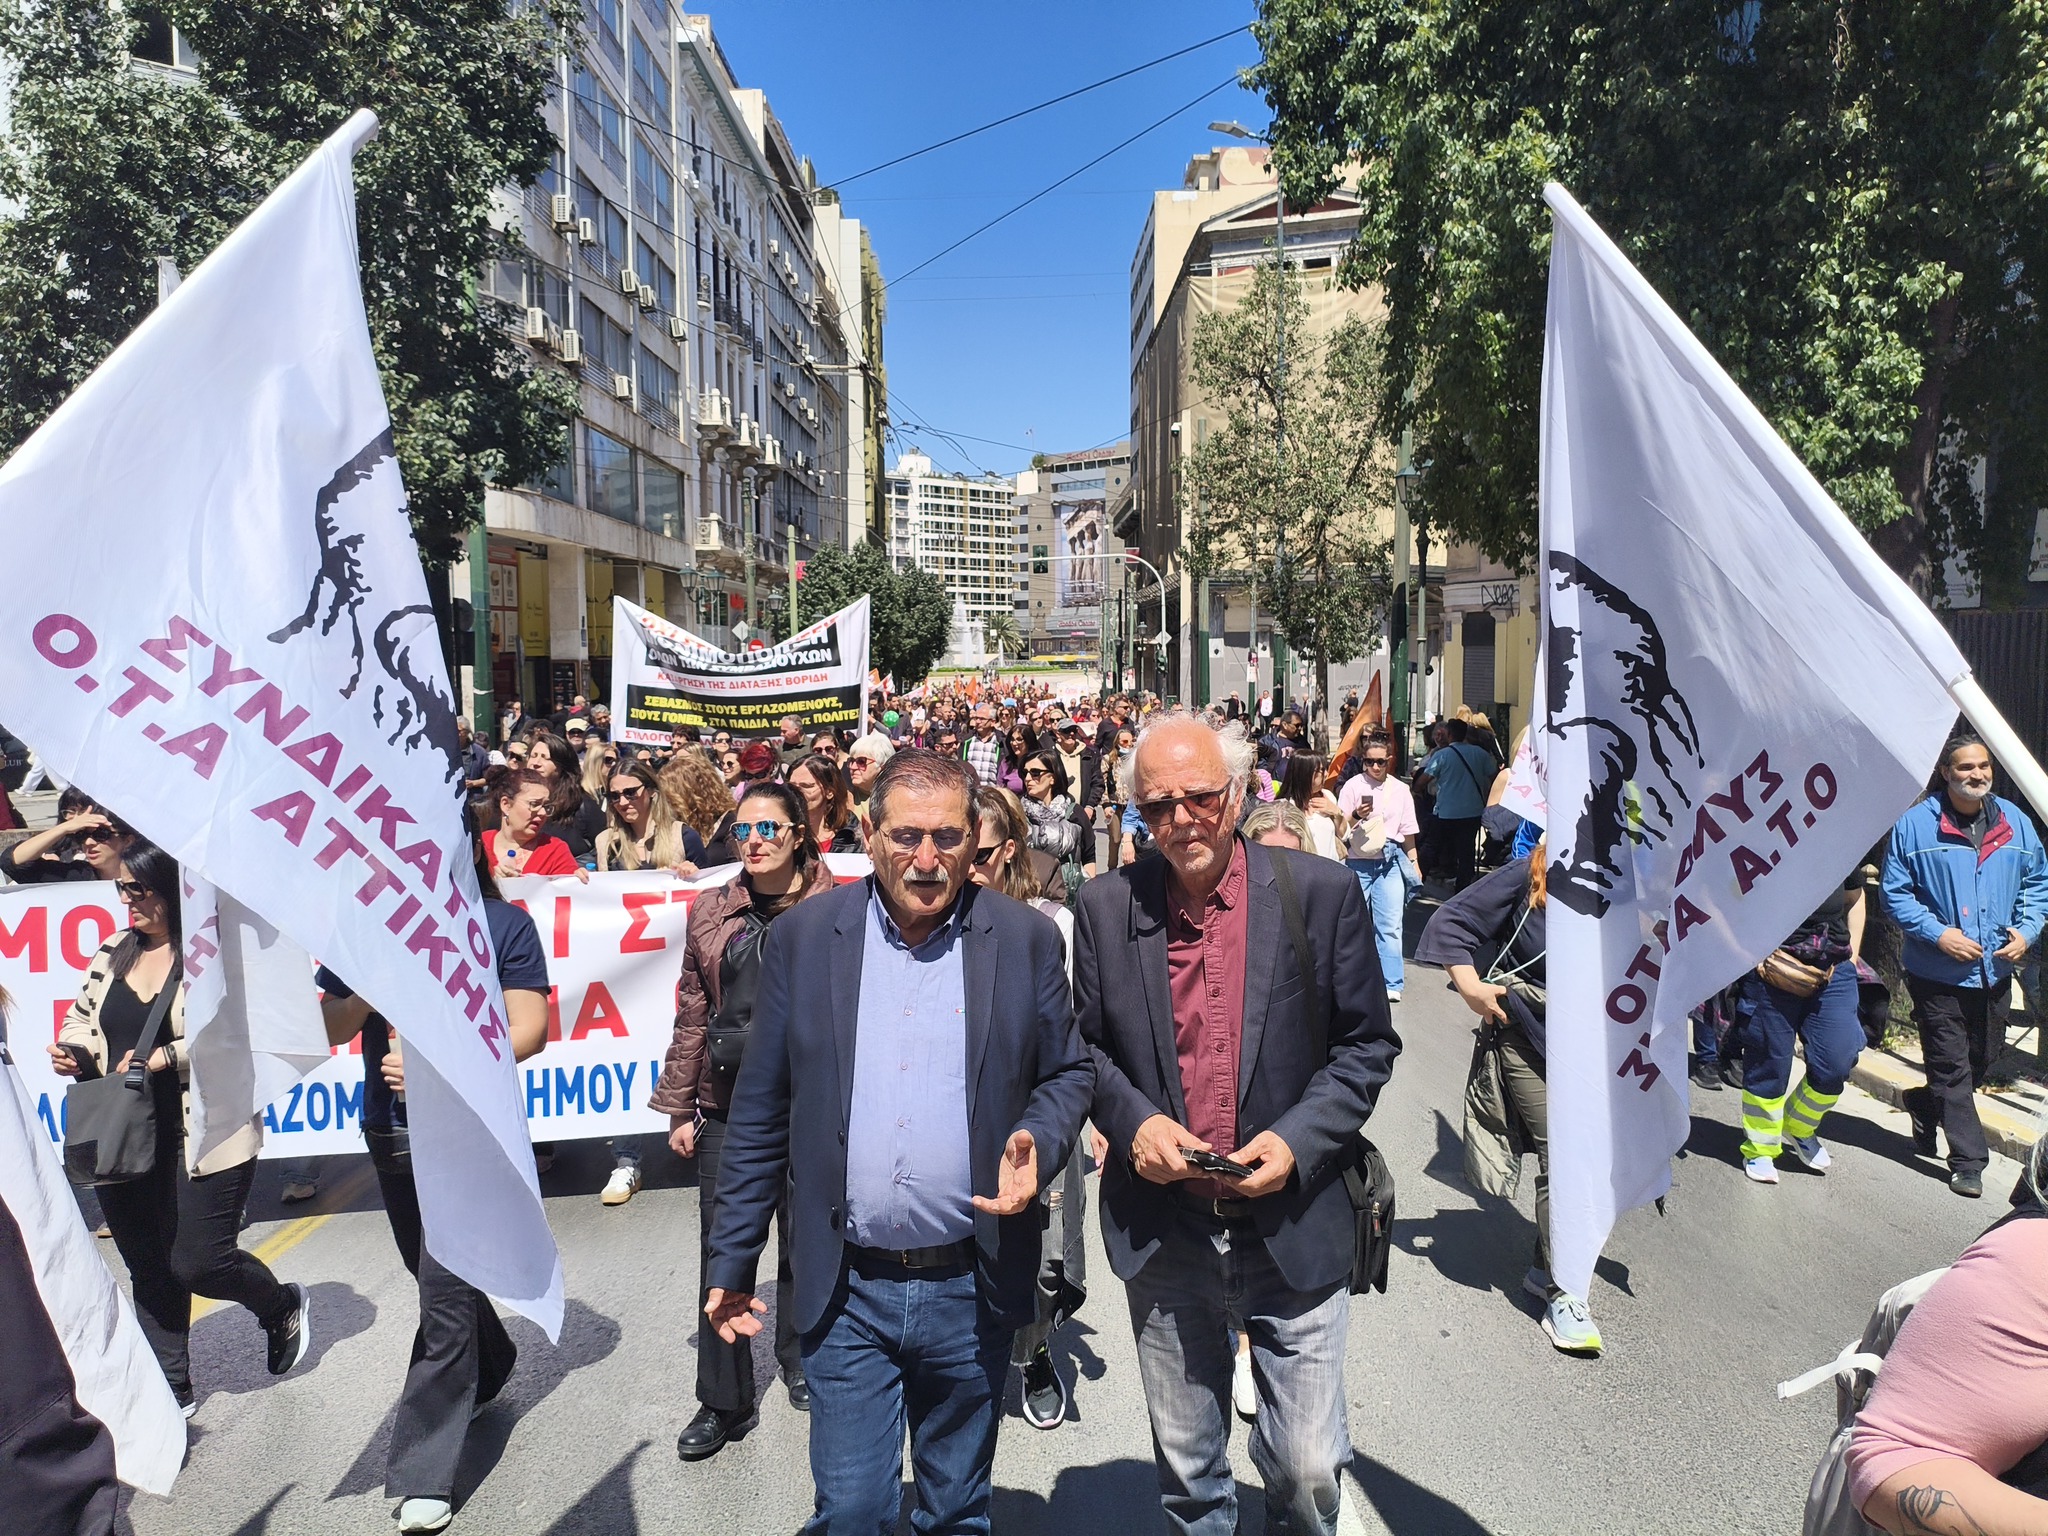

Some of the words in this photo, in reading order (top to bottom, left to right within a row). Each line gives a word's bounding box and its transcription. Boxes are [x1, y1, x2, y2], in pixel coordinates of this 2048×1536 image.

[707, 680, 727, 690] ΤΗΣ
[729, 678, 783, 691] ΔΙΑΤΑΞΗΣ
[785, 673, 828, 686] ΒΟΡΙΔΗ
[644, 695, 704, 712] ΣΕΒΑΣΜΟΣ
[705, 703, 739, 716] ΣΤΟΥΣ
[740, 696, 843, 716] ΕΡΓΑΖΟΜΕΝΟΥΣ,
[630, 708, 661, 721] ΣΤΟΥΣ
[708, 717, 728, 727] ΣΤΑ
[729, 717, 771, 730] ΠΑΙΔΙΑ
[625, 731, 673, 743] ΣΥΛΛΟΓΟ
[140, 614, 491, 969] ΣΥΝΔΙΚΑΤΟ
[250, 789, 508, 1062] ΑΤΤΙΚΗΣ
[526, 1060, 638, 1119] ΗΜΟΥ
